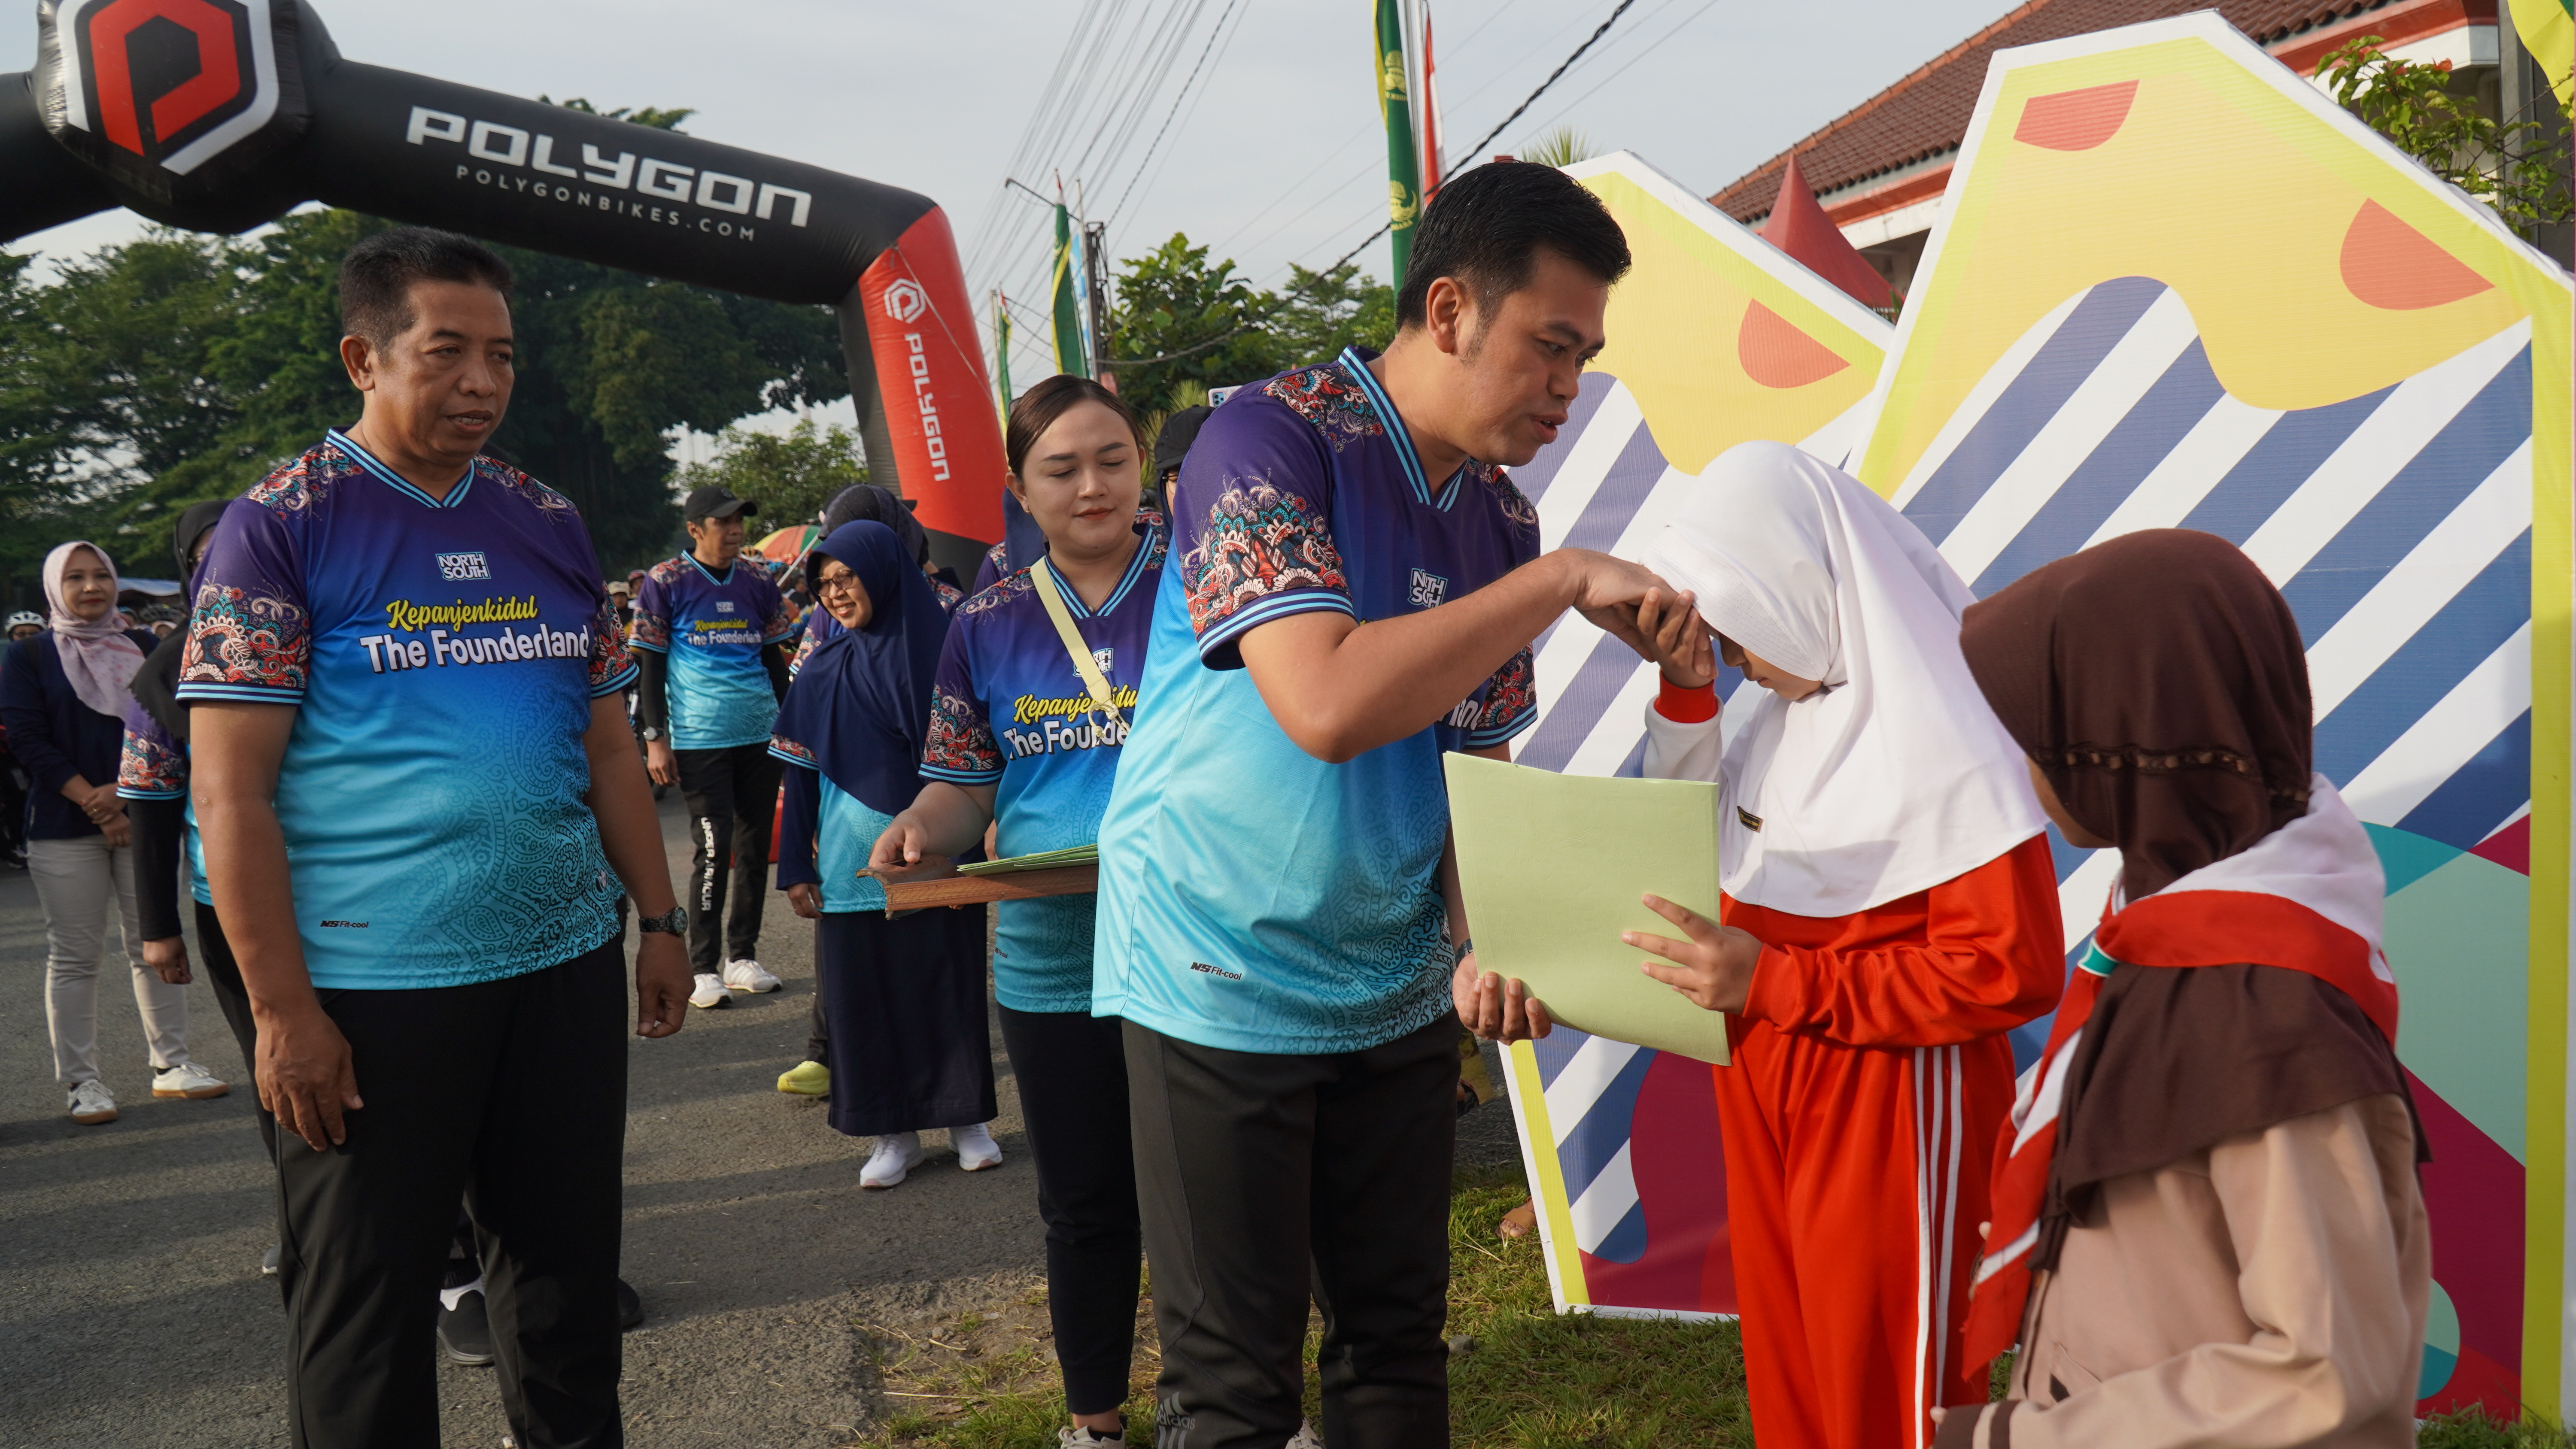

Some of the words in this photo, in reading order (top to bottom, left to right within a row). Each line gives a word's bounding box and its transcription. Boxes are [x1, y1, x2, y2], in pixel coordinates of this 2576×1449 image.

[406, 106, 812, 227] POLYGON
[456, 165, 754, 241] POLYGONBIKES.COM
[904, 333, 950, 482] POLYGON
[438, 554, 485, 567] NORTH
[443, 566, 489, 579] SOUTH
[386, 595, 538, 633] Kepanjenkidul
[360, 634, 426, 672] The
[431, 624, 588, 665] Founderland
[1093, 649, 1111, 663] RTH
[1003, 727, 1044, 759] The
[1044, 721, 1130, 753] Founde
[1190, 961, 1212, 973] NS
[1211, 966, 1242, 980] Fit-cool
[1156, 1410, 1196, 1430] adidas
